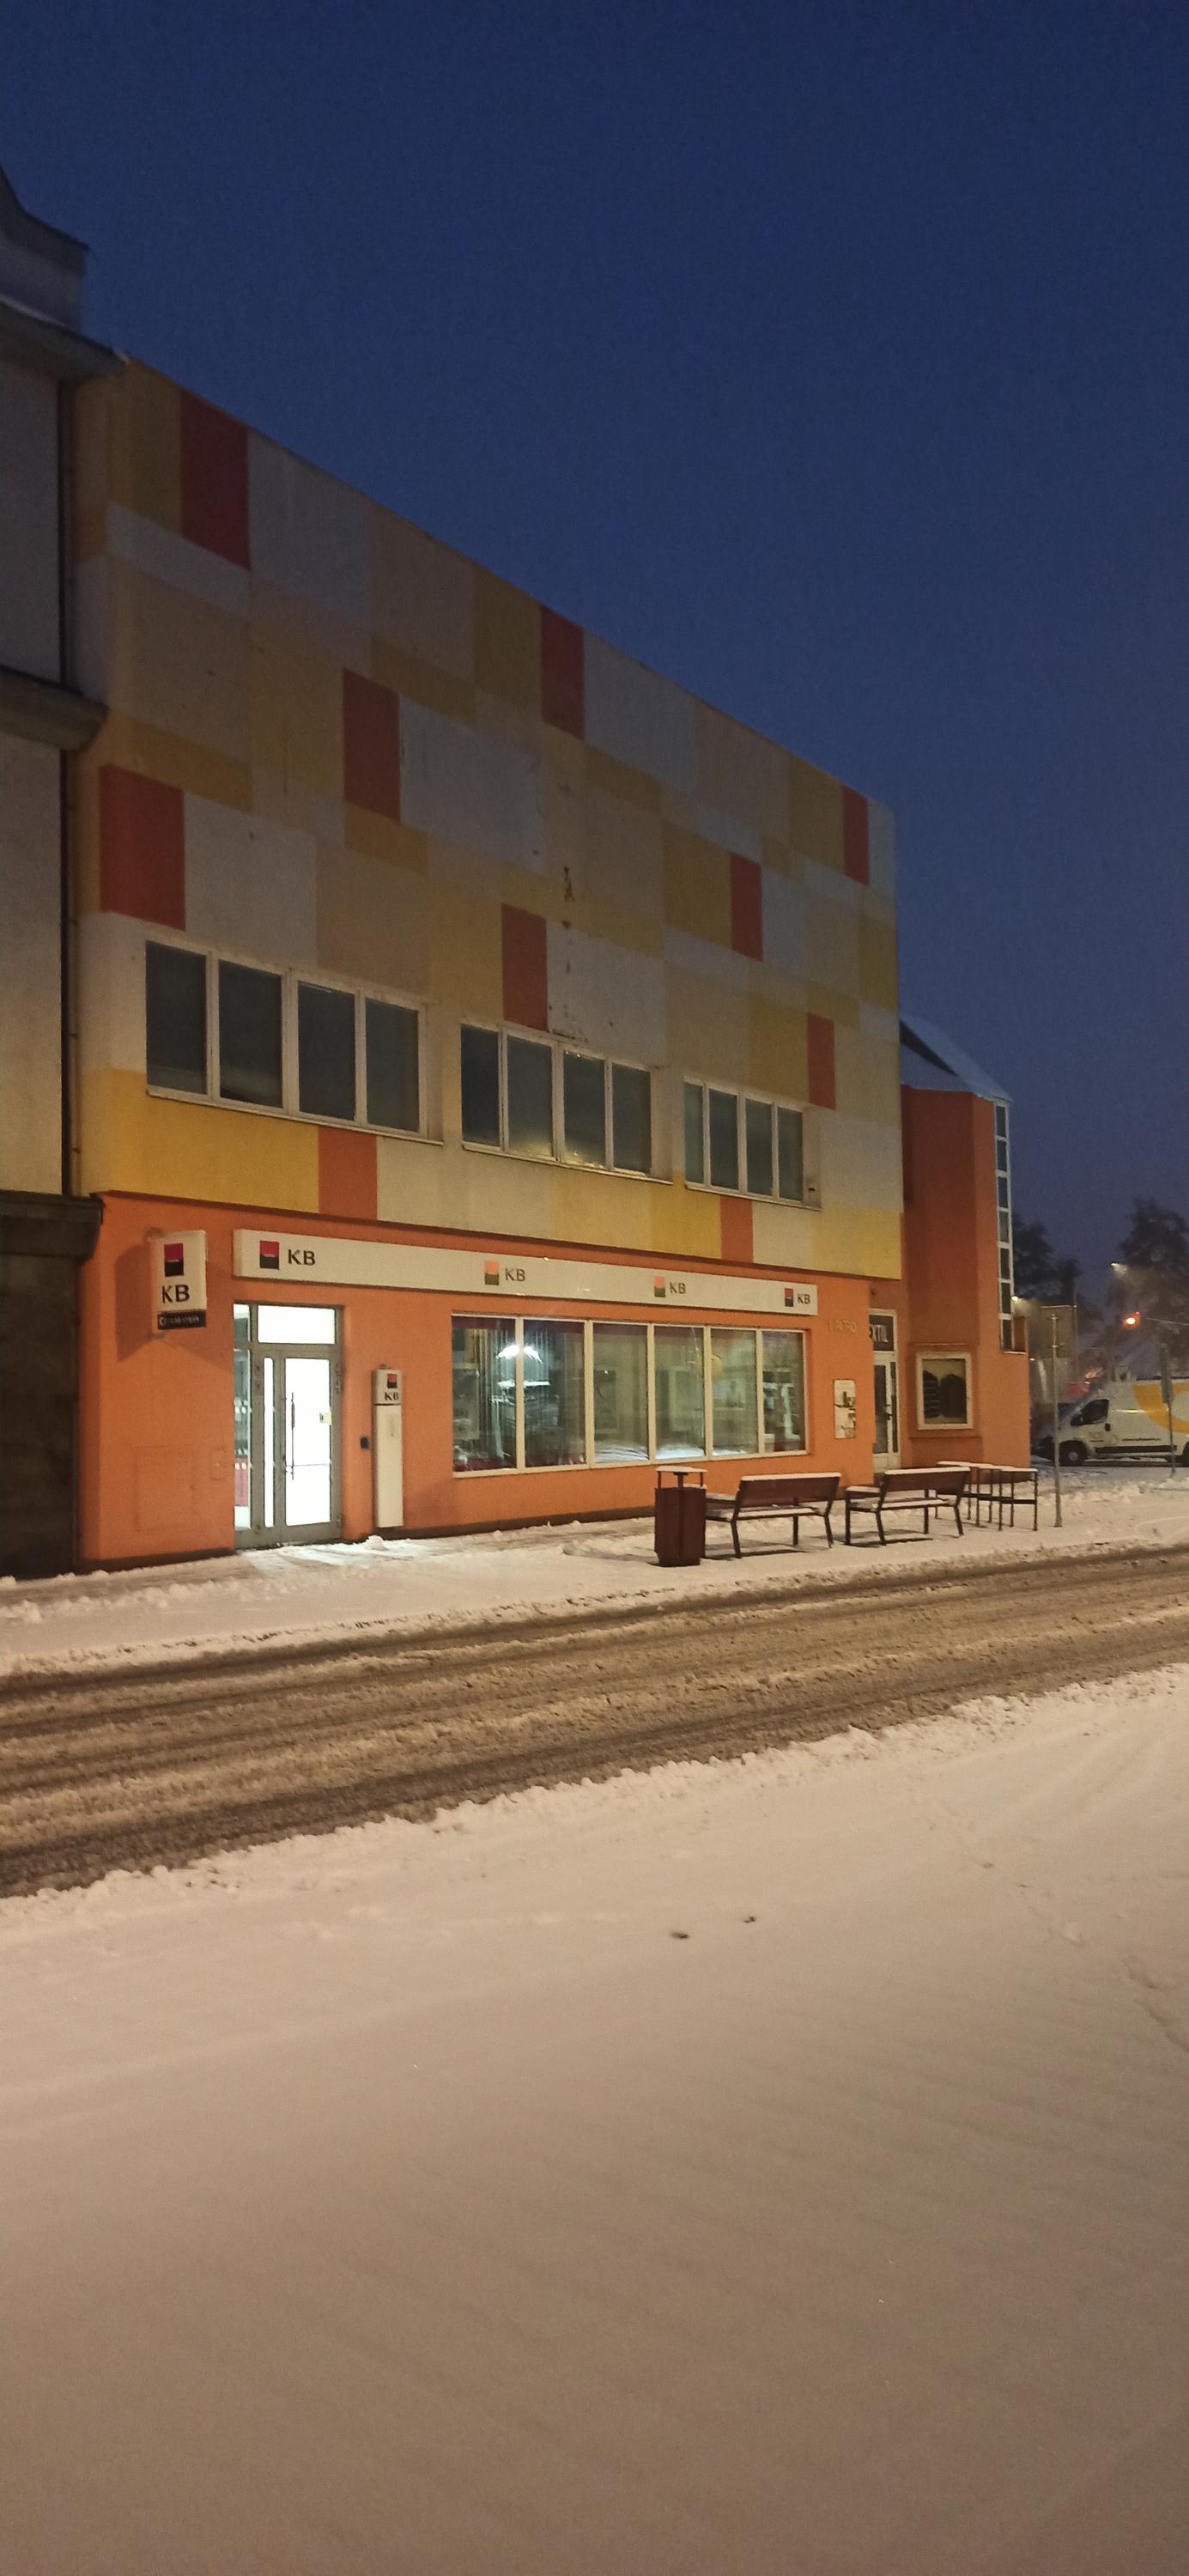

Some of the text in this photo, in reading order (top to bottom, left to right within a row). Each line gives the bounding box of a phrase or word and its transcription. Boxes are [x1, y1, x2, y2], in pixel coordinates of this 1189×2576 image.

[288, 1249, 316, 1266] KB
[505, 1267, 526, 1282] KB
[161, 1285, 191, 1303] KB
[670, 1280, 687, 1295] KB
[797, 1292, 811, 1304] KB
[384, 1391, 399, 1401] KB
